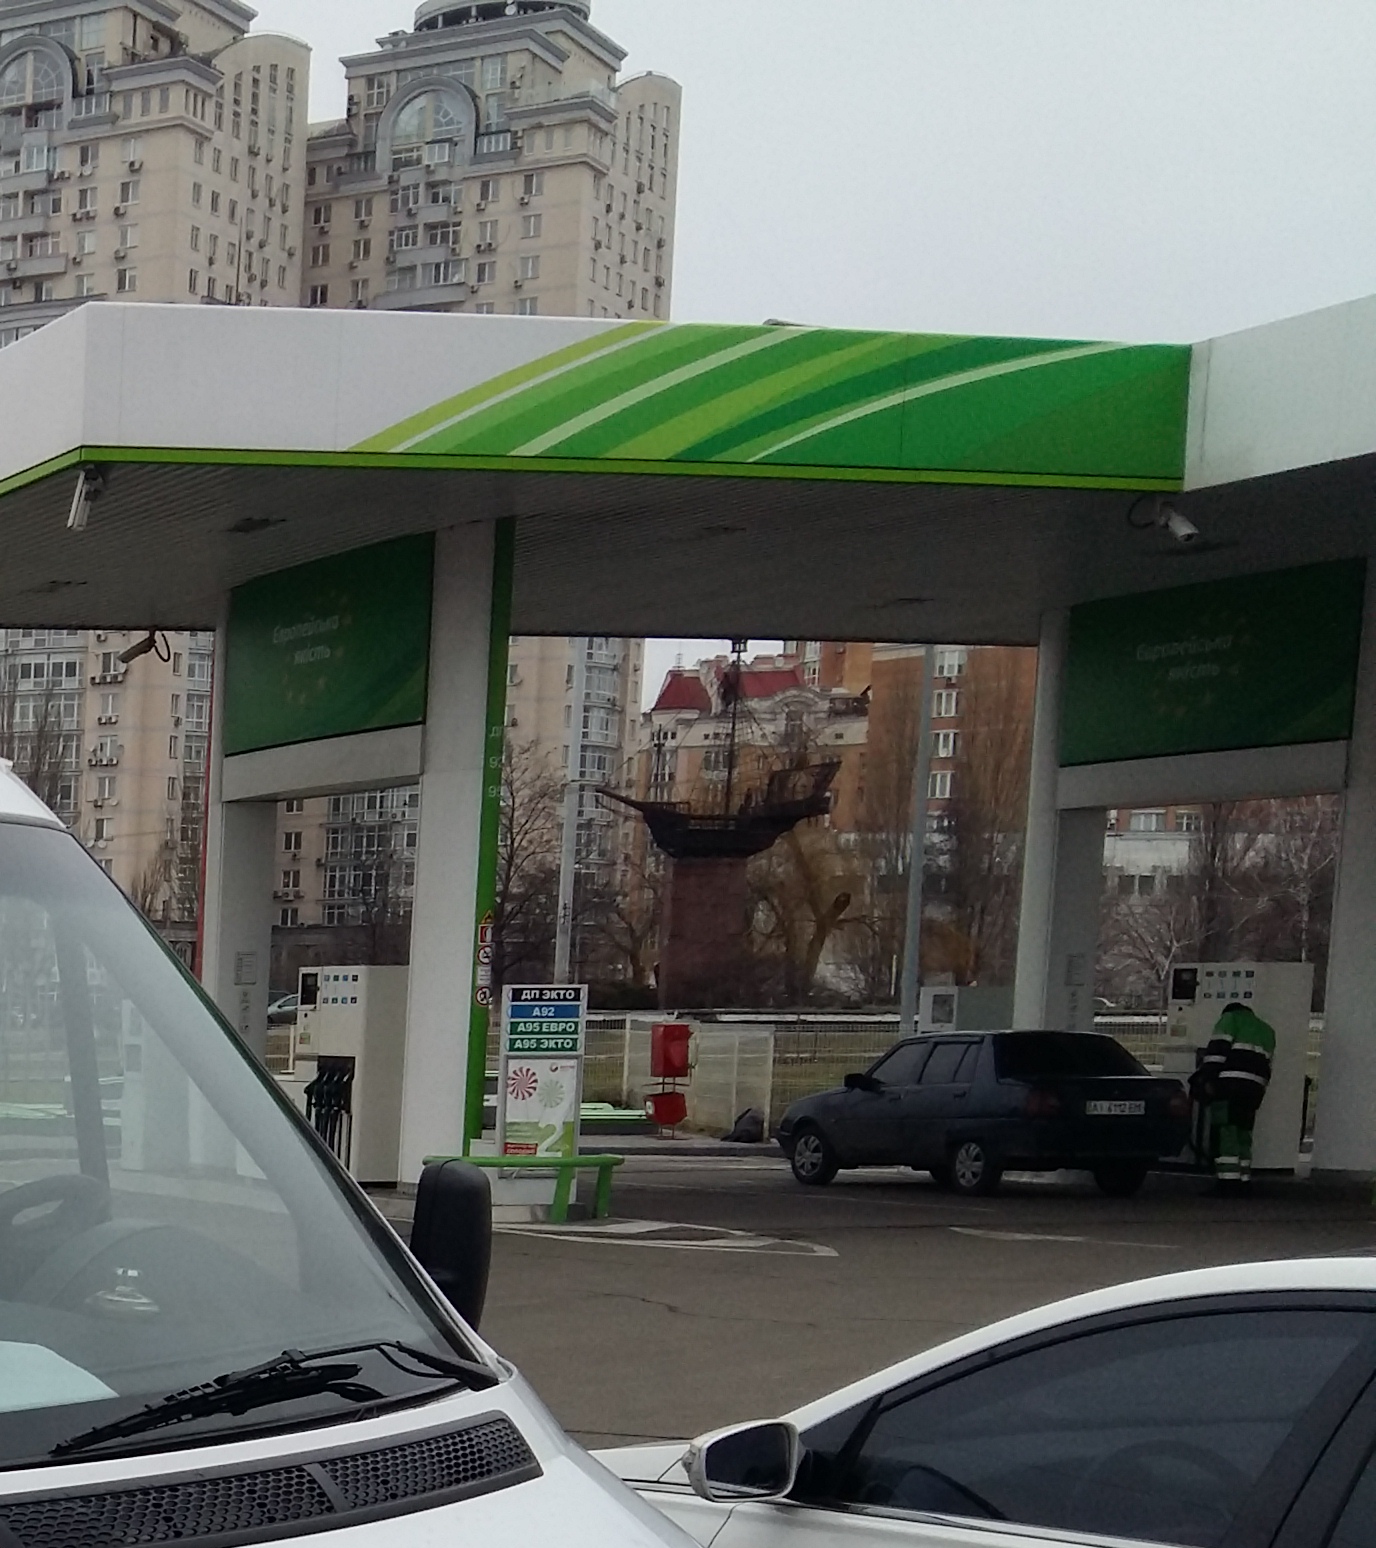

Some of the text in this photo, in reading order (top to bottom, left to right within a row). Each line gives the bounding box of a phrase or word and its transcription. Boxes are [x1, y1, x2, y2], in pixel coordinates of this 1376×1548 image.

[521, 990, 575, 1000] ДП ЭКТО
[532, 1007, 555, 1017] А92
[517, 1022, 575, 1032] А95 ЕВРО
[514, 1039, 573, 1049] А95 ЭКТО
